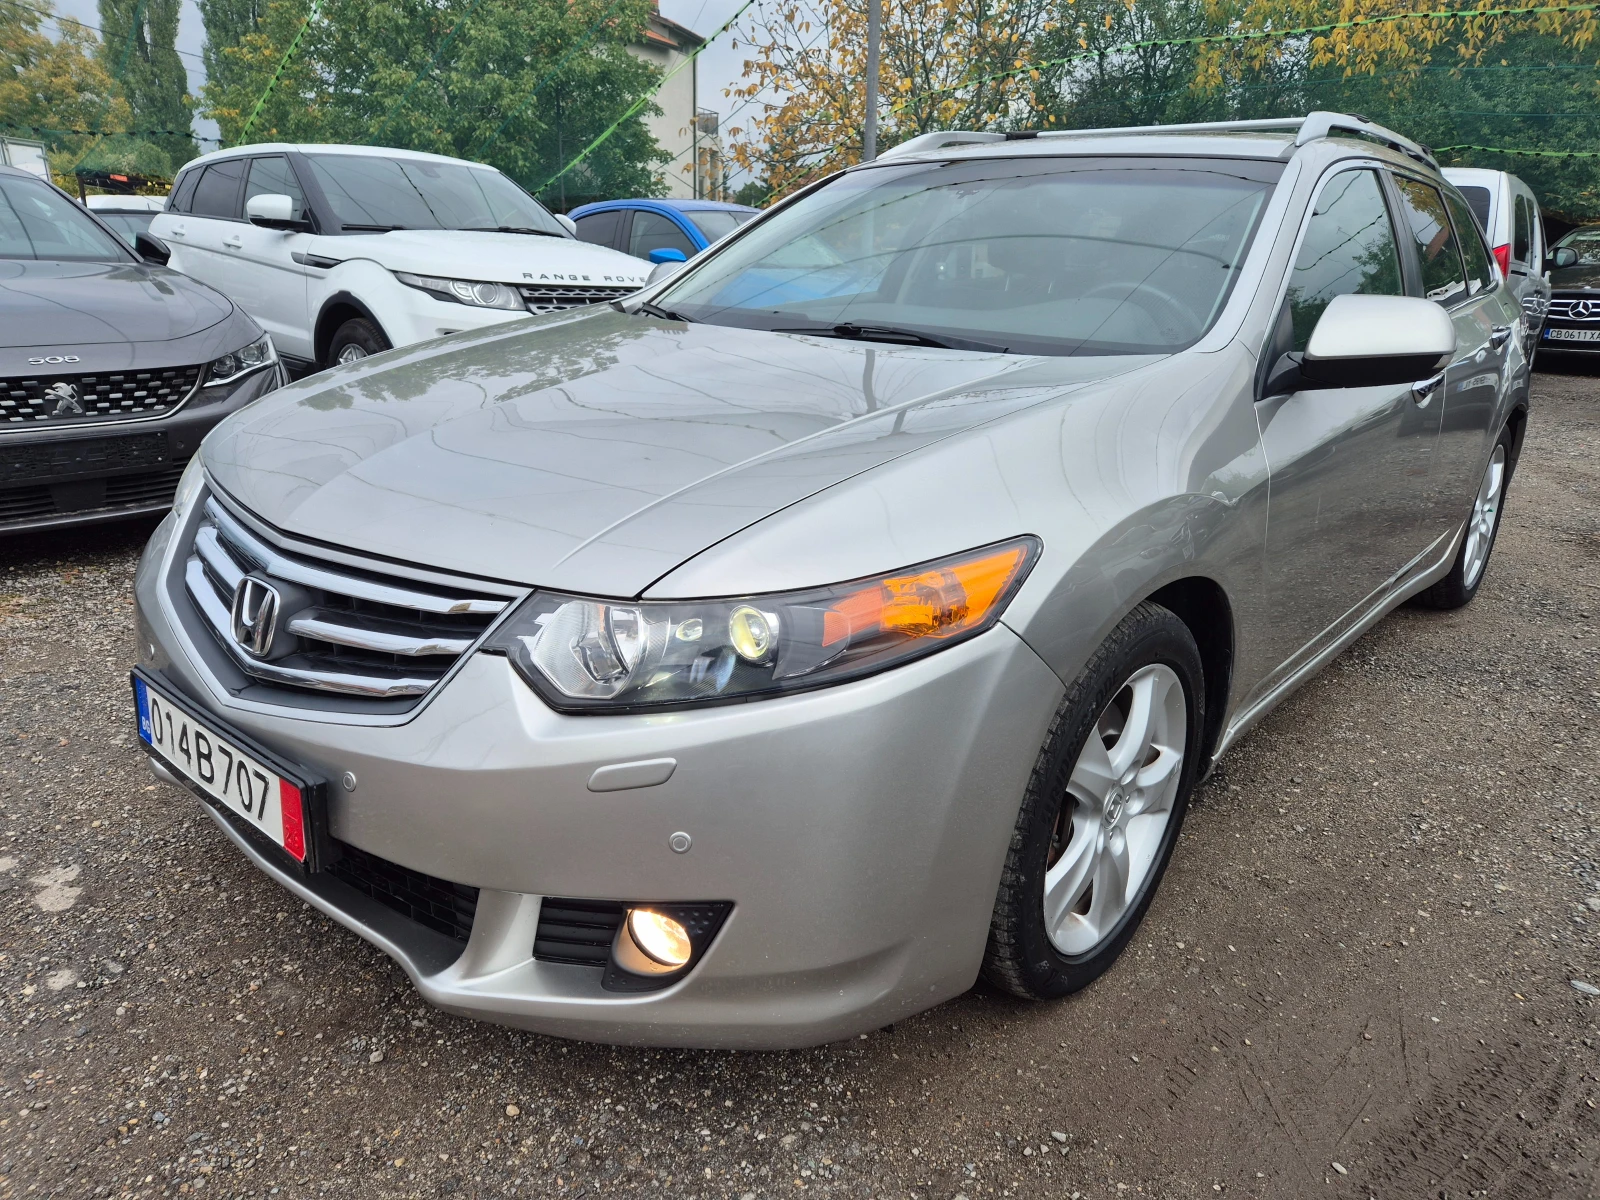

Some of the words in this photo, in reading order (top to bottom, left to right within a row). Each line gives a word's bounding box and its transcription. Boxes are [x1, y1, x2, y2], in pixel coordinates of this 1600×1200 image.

[522, 272, 591, 281] RANGE
[28, 355, 80, 365] 508
[151, 697, 270, 821] 014B707
